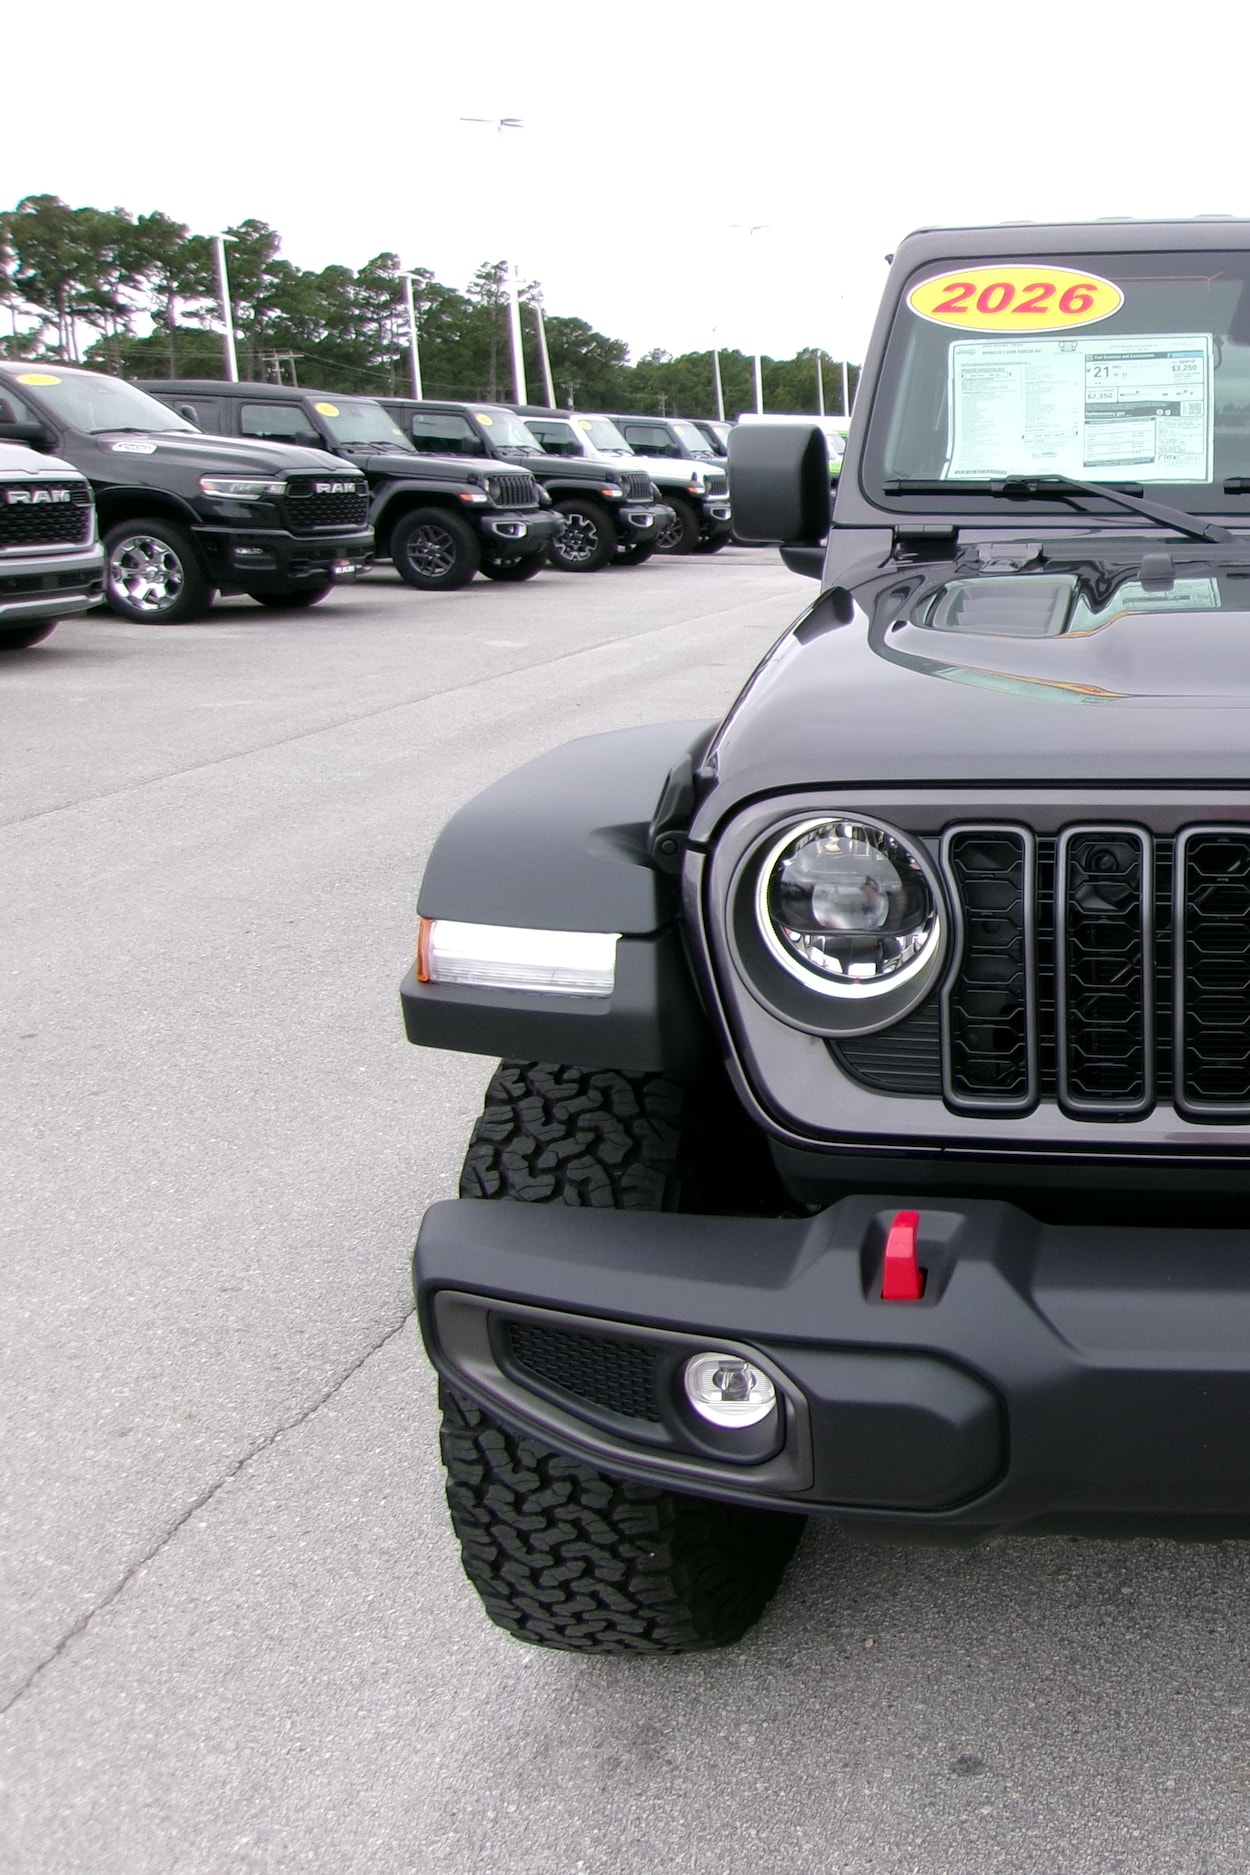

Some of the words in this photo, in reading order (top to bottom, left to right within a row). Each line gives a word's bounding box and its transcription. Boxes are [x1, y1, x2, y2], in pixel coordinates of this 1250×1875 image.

[931, 282, 1099, 315] 2026
[1094, 366, 1109, 378] 21
[315, 483, 356, 494] RAM
[7, 490, 71, 504] RAM
